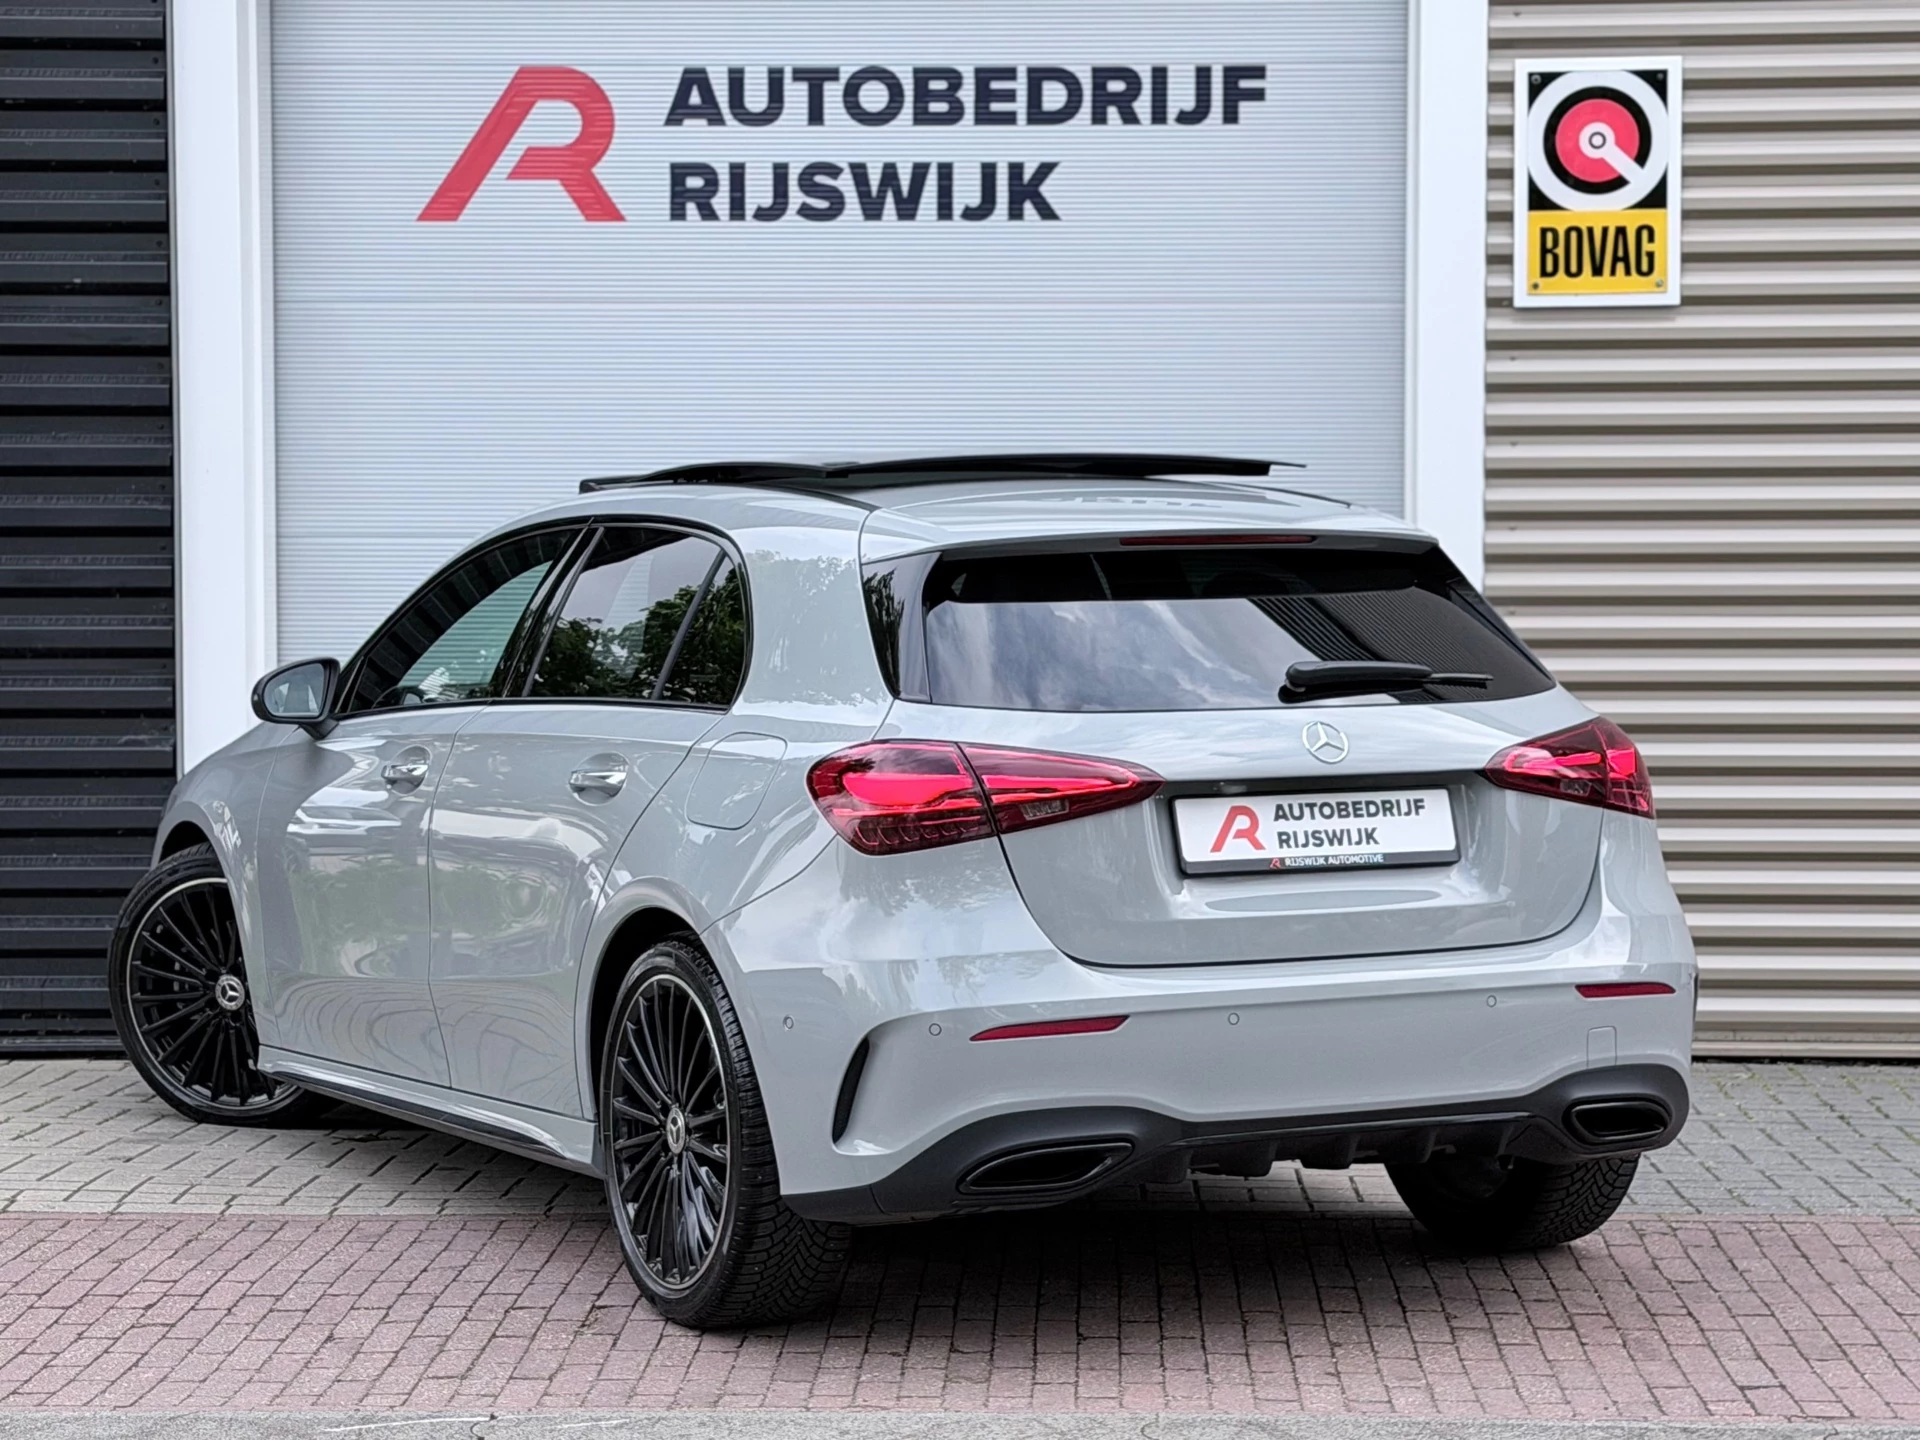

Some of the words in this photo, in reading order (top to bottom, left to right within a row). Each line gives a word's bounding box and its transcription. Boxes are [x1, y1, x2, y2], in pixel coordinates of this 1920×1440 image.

[664, 65, 1266, 126] AUTOBEDRIJF
[669, 161, 1062, 222] RIJSWIJK
[1539, 224, 1656, 279] BOVAG
[1273, 798, 1426, 822] AUTOBEDRIJF
[1277, 827, 1380, 849] RIJSWIJK
[1284, 856, 1327, 867] RIJSWIJK
[1328, 853, 1384, 866] AUTOMOTIVE
